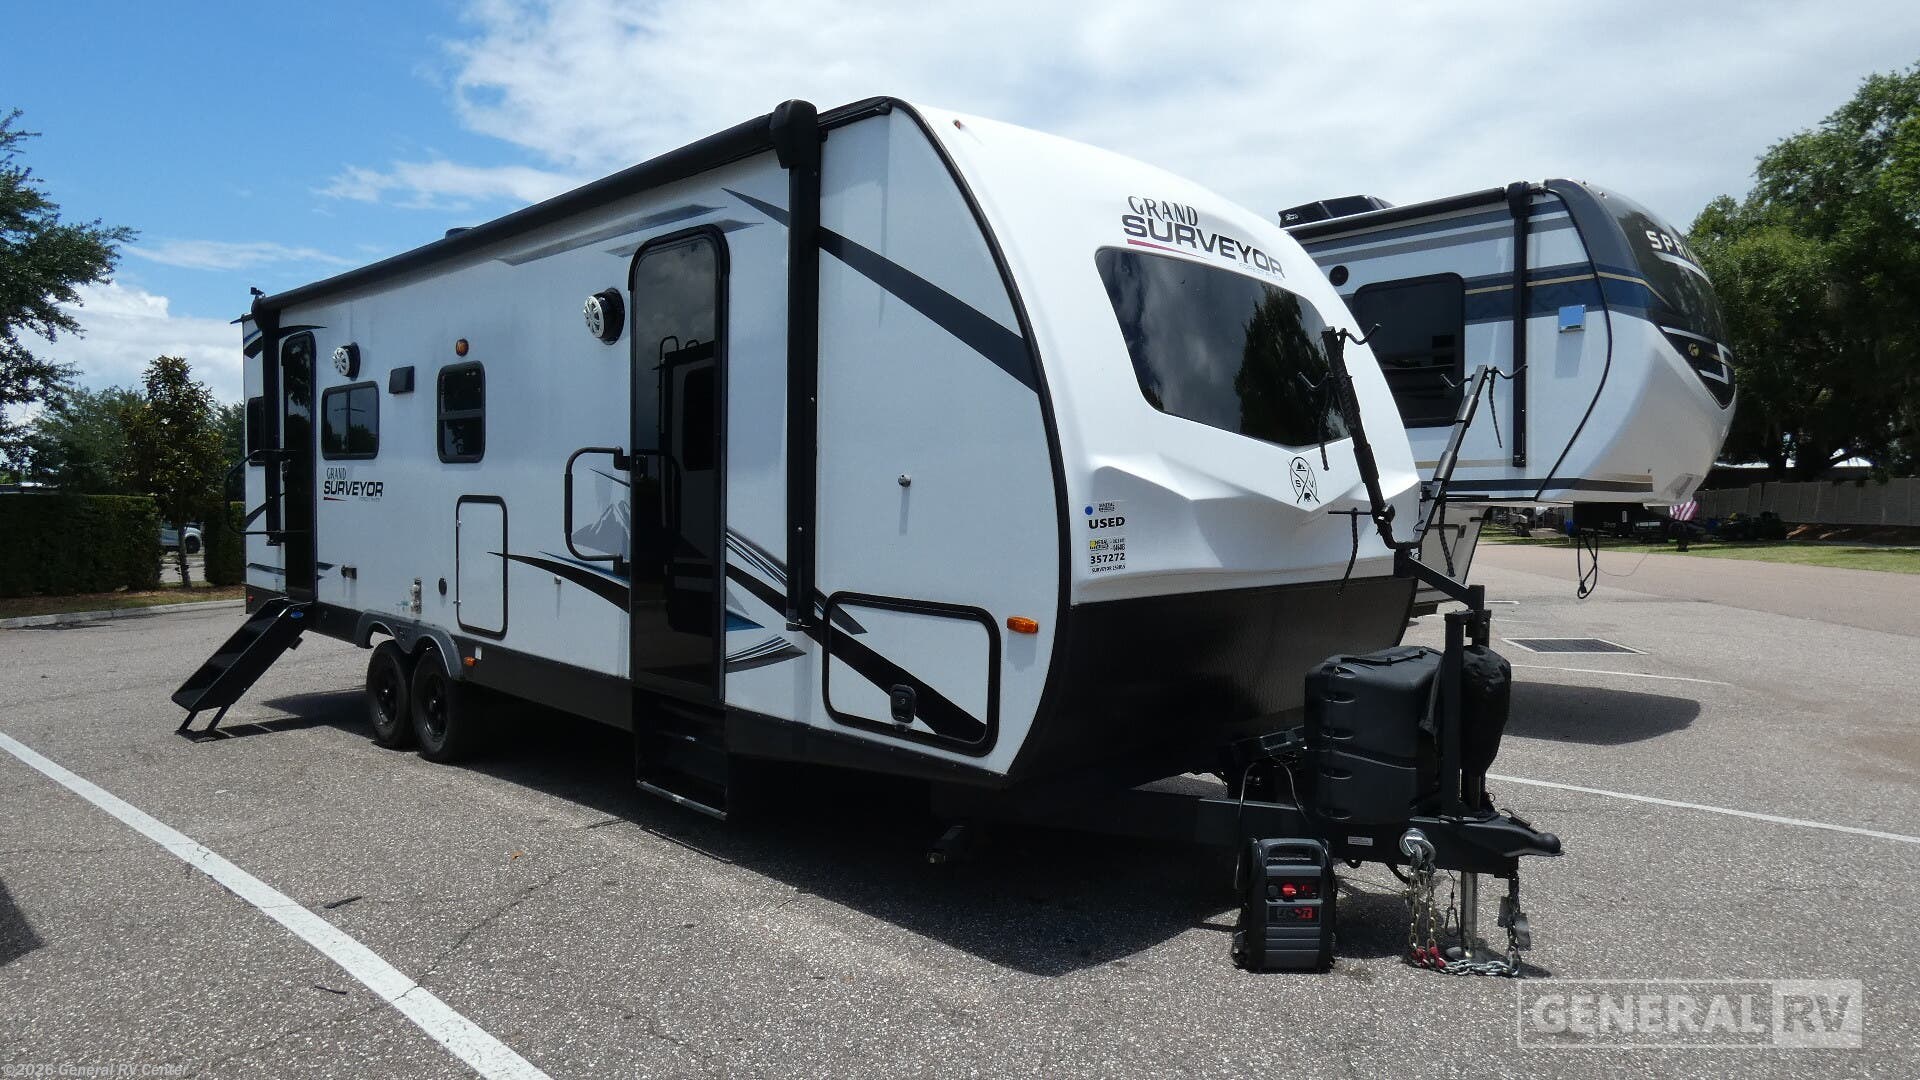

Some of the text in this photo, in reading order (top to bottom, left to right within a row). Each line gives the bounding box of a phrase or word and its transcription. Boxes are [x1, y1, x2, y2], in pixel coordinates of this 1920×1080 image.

[1127, 195, 1199, 227] GRAND
[1121, 214, 1286, 279] SURVEYOR
[326, 467, 347, 481] GRAND
[323, 480, 384, 497] SURVEYOR
[1088, 516, 1126, 529] USED
[1090, 552, 1125, 564] 357272
